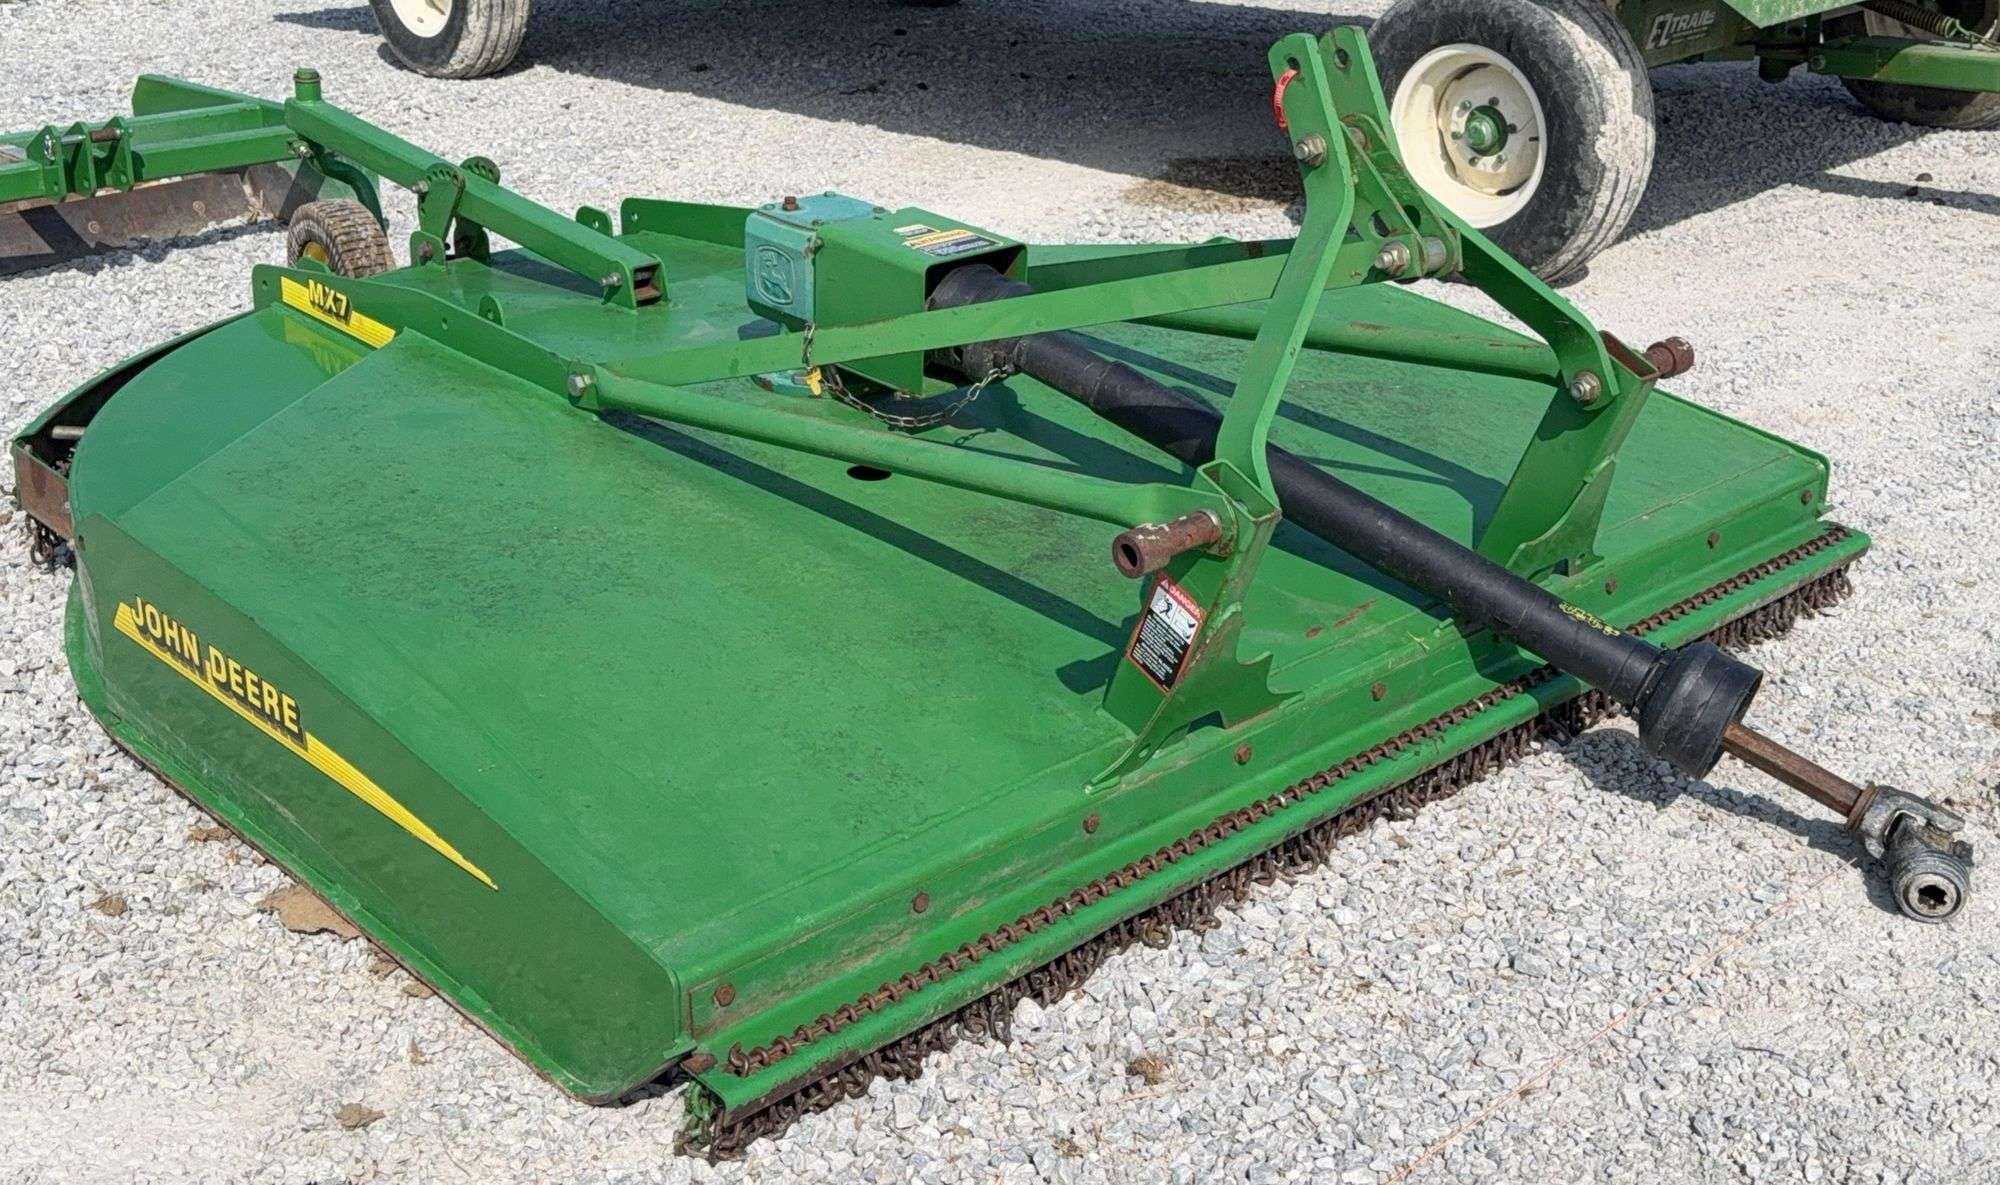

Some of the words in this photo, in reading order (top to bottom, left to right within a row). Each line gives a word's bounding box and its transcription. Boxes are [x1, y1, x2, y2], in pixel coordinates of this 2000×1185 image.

[1645, 13, 1674, 50] EZ
[308, 278, 347, 317] MX7
[130, 595, 201, 667] JOHN
[208, 644, 299, 734] DEERE
